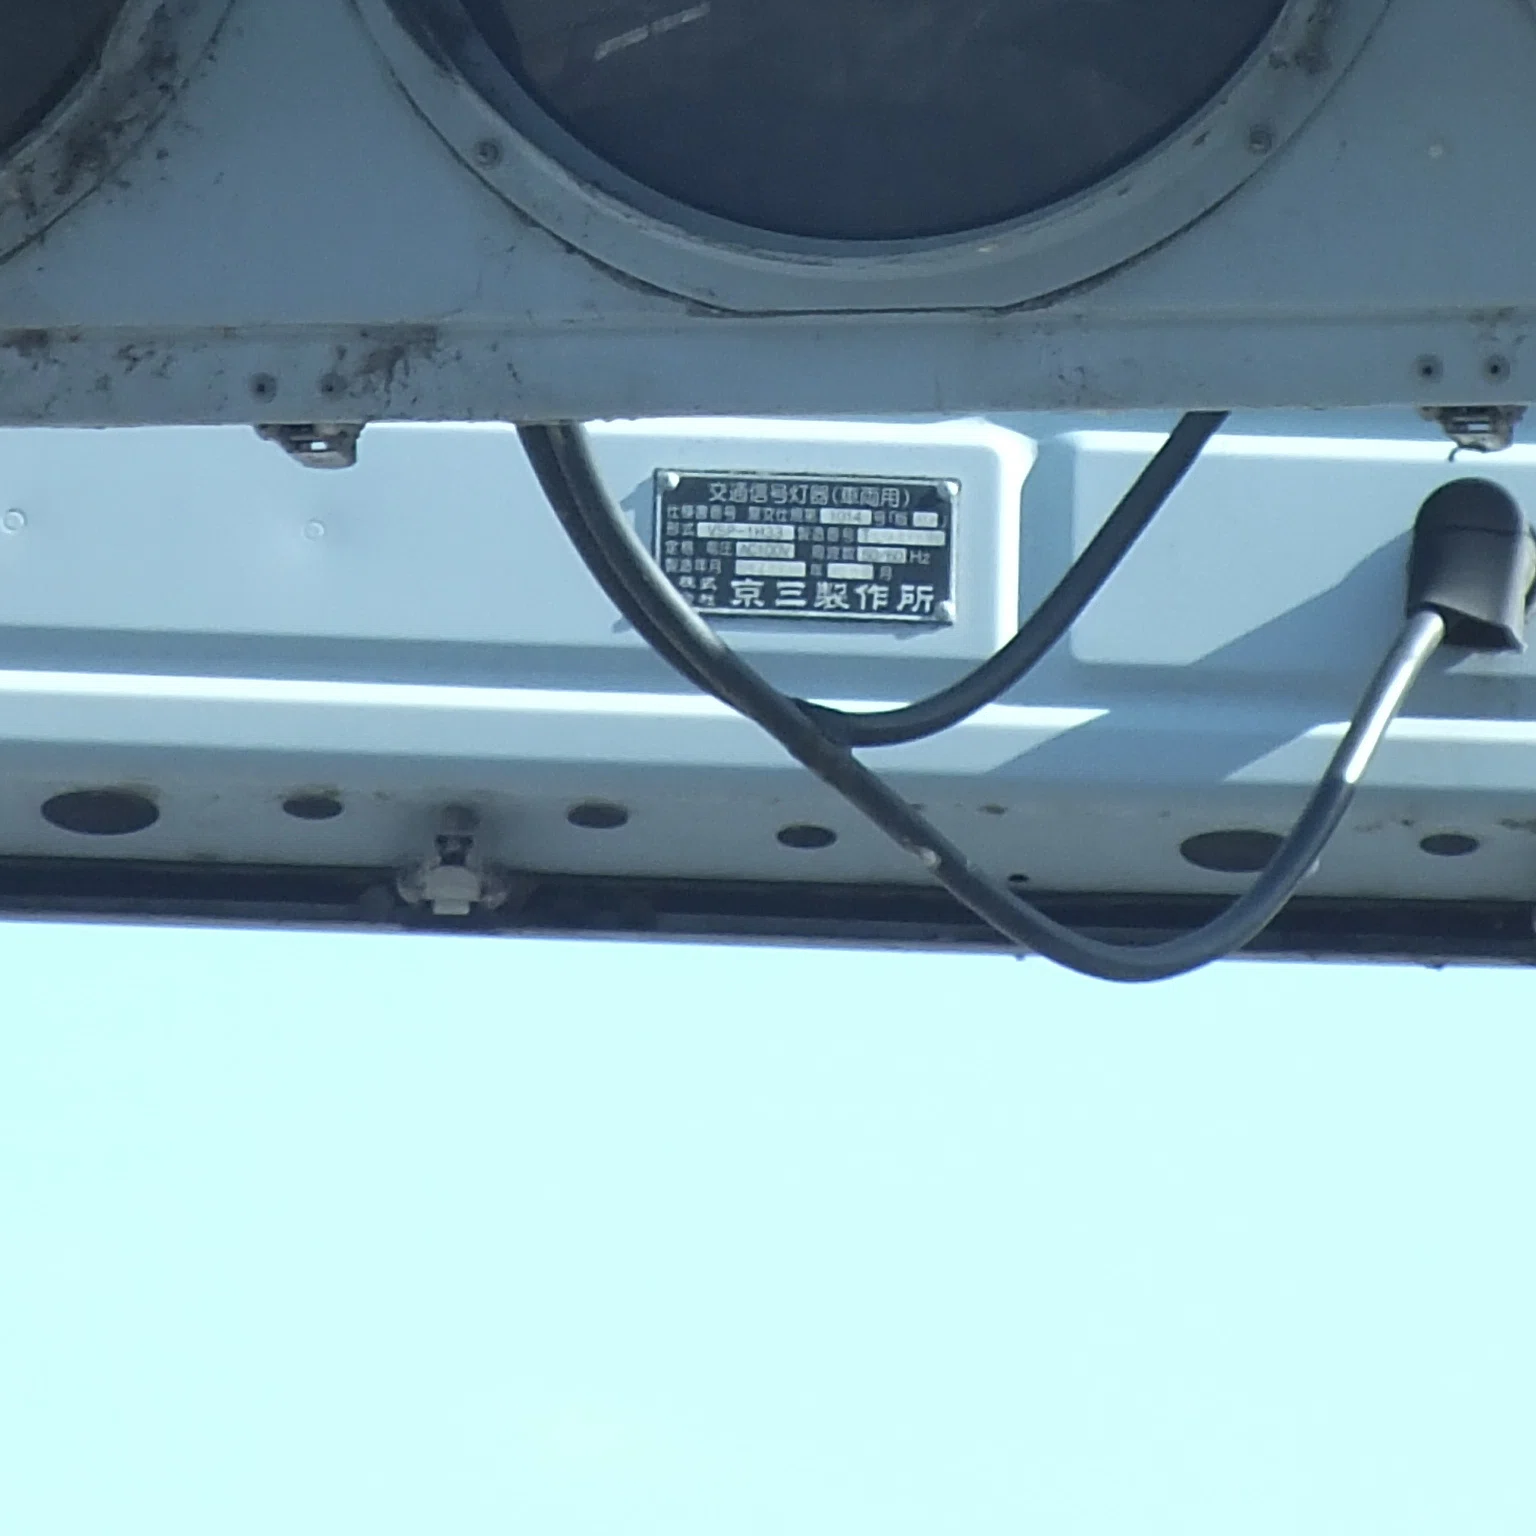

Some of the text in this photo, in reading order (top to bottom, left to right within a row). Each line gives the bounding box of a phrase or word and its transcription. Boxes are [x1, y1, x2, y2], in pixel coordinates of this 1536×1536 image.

[909, 550, 931, 565] Hz
[730, 578, 936, 614] 京三製作所
